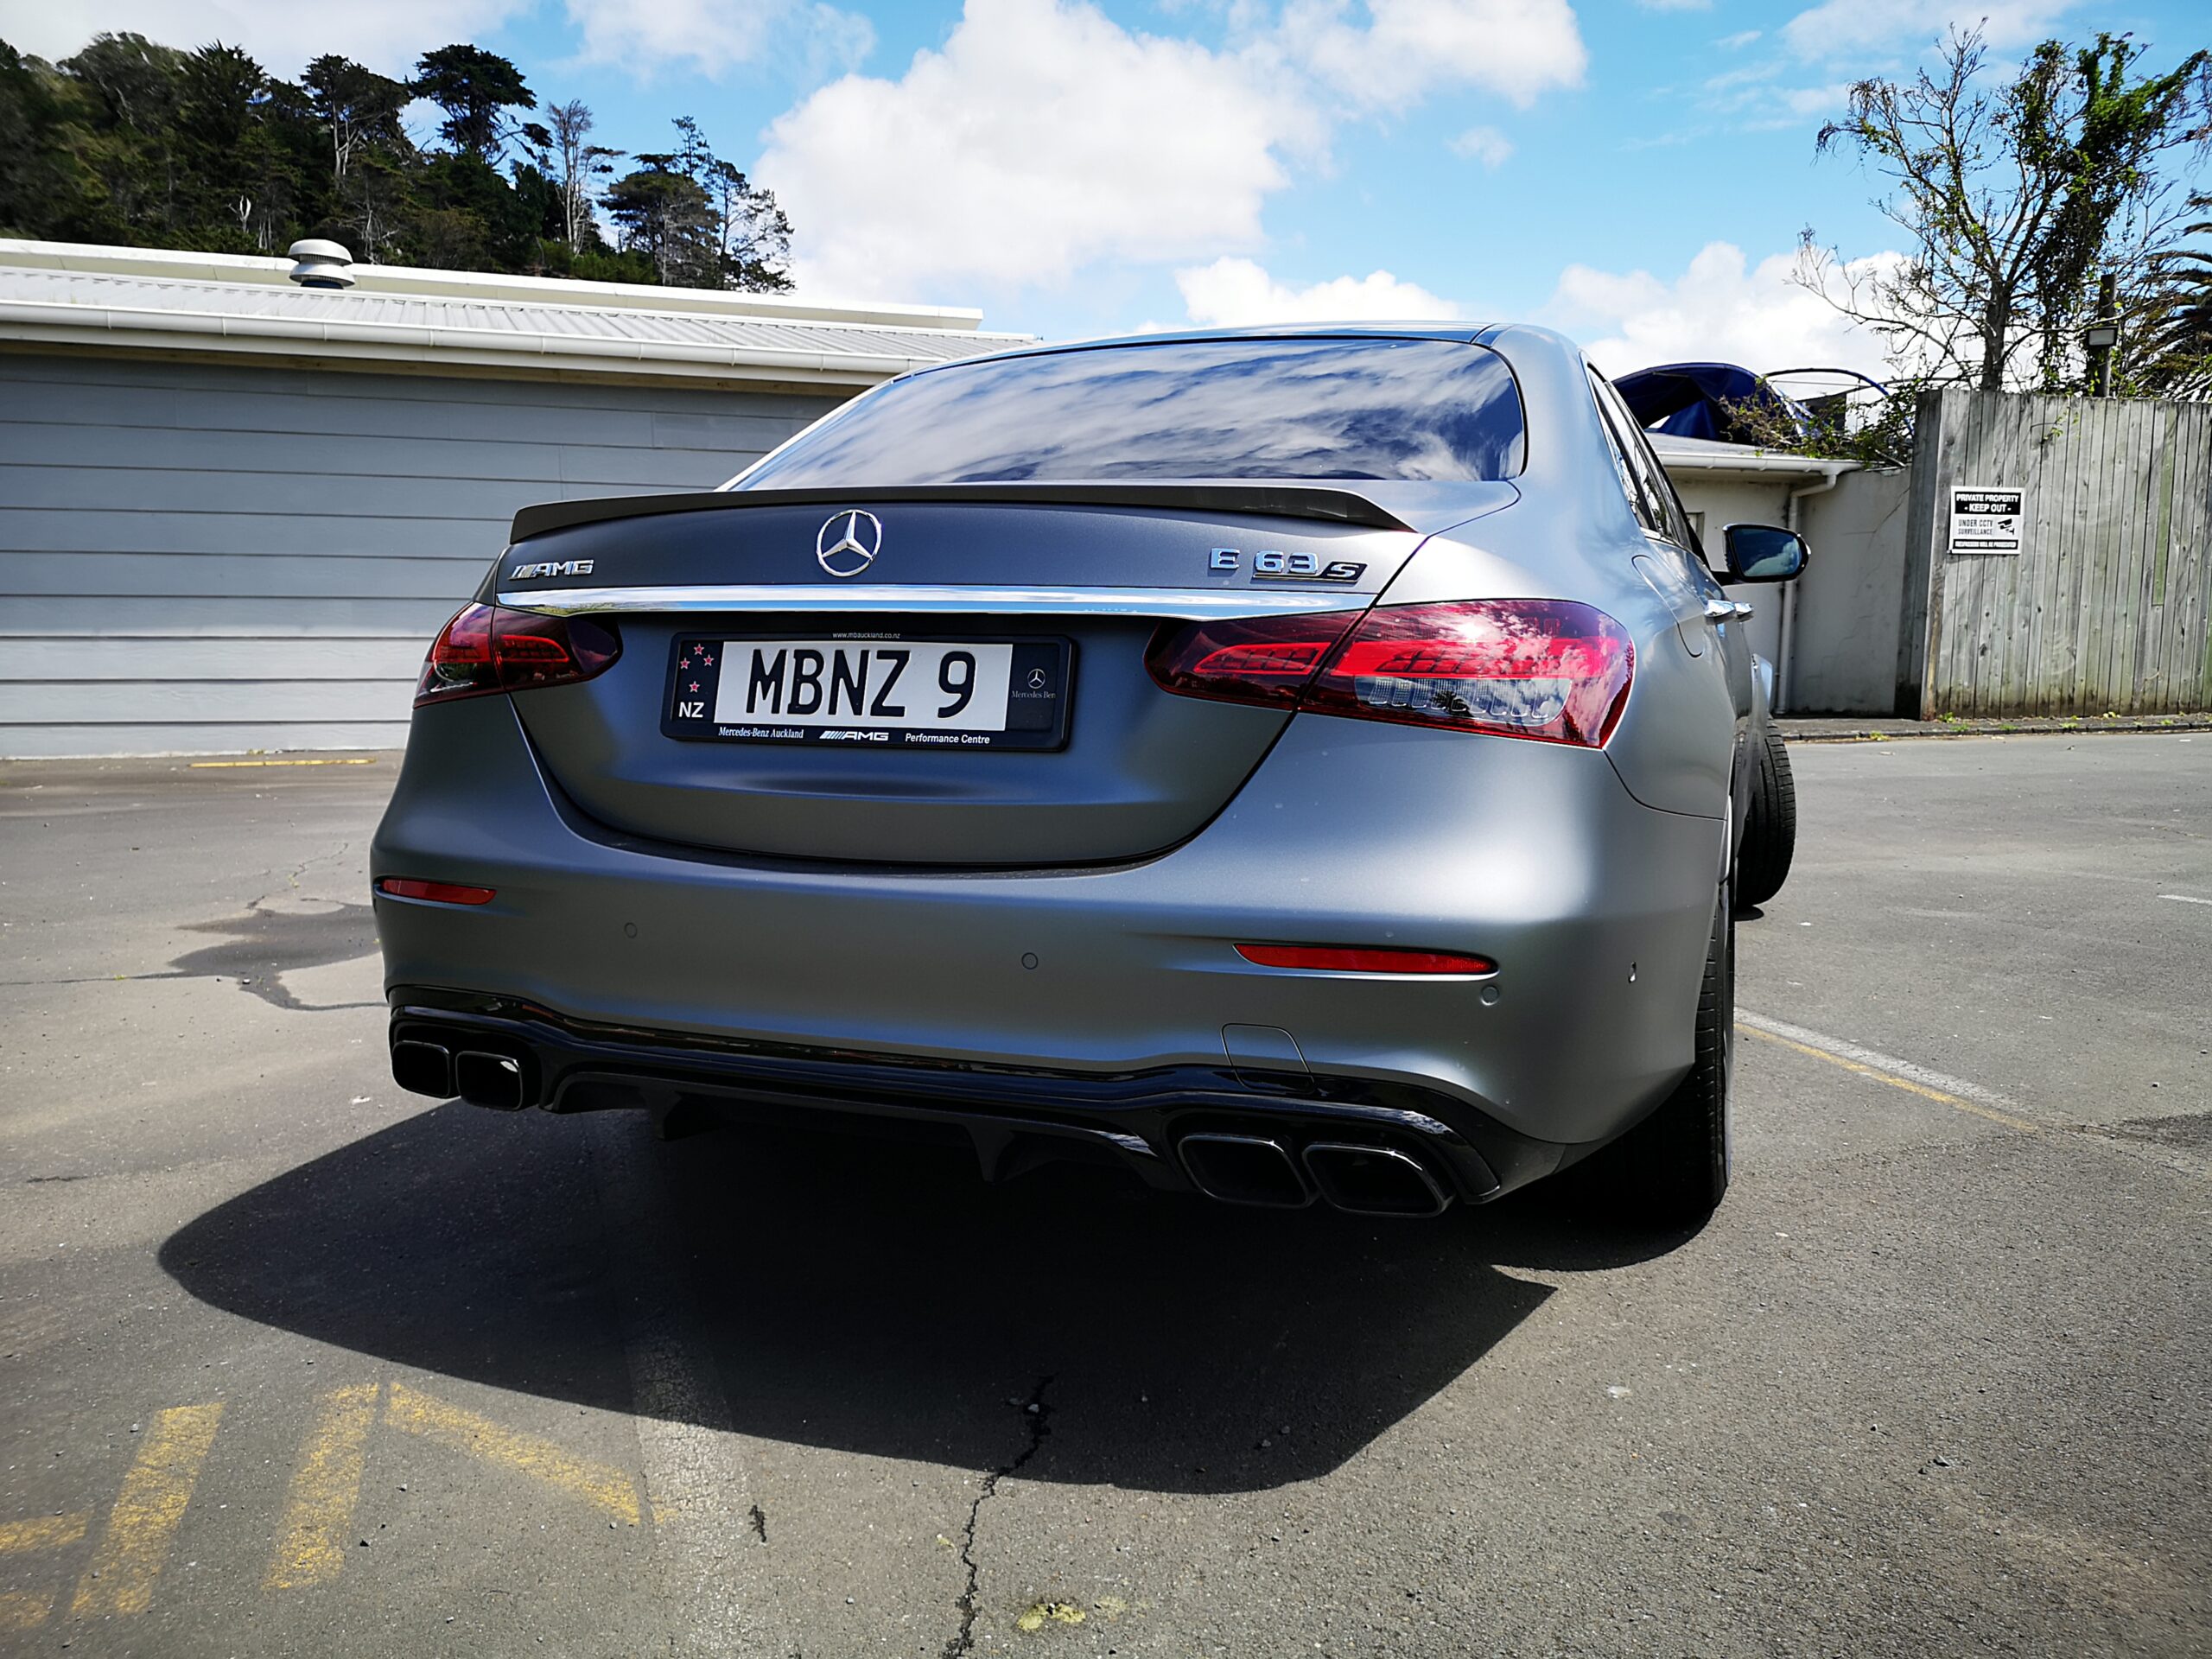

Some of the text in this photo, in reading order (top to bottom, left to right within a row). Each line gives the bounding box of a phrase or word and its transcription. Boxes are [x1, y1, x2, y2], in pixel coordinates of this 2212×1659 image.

[1956, 493, 1984, 502] PRIVATE
[1991, 504, 2006, 512] OUT
[1211, 548, 1240, 569] E
[746, 649, 976, 719] MBNZ 9
[678, 702, 705, 718] NZ
[718, 727, 804, 739] Mercedes-Benz Auckland
[905, 733, 990, 744] Performance Centre
